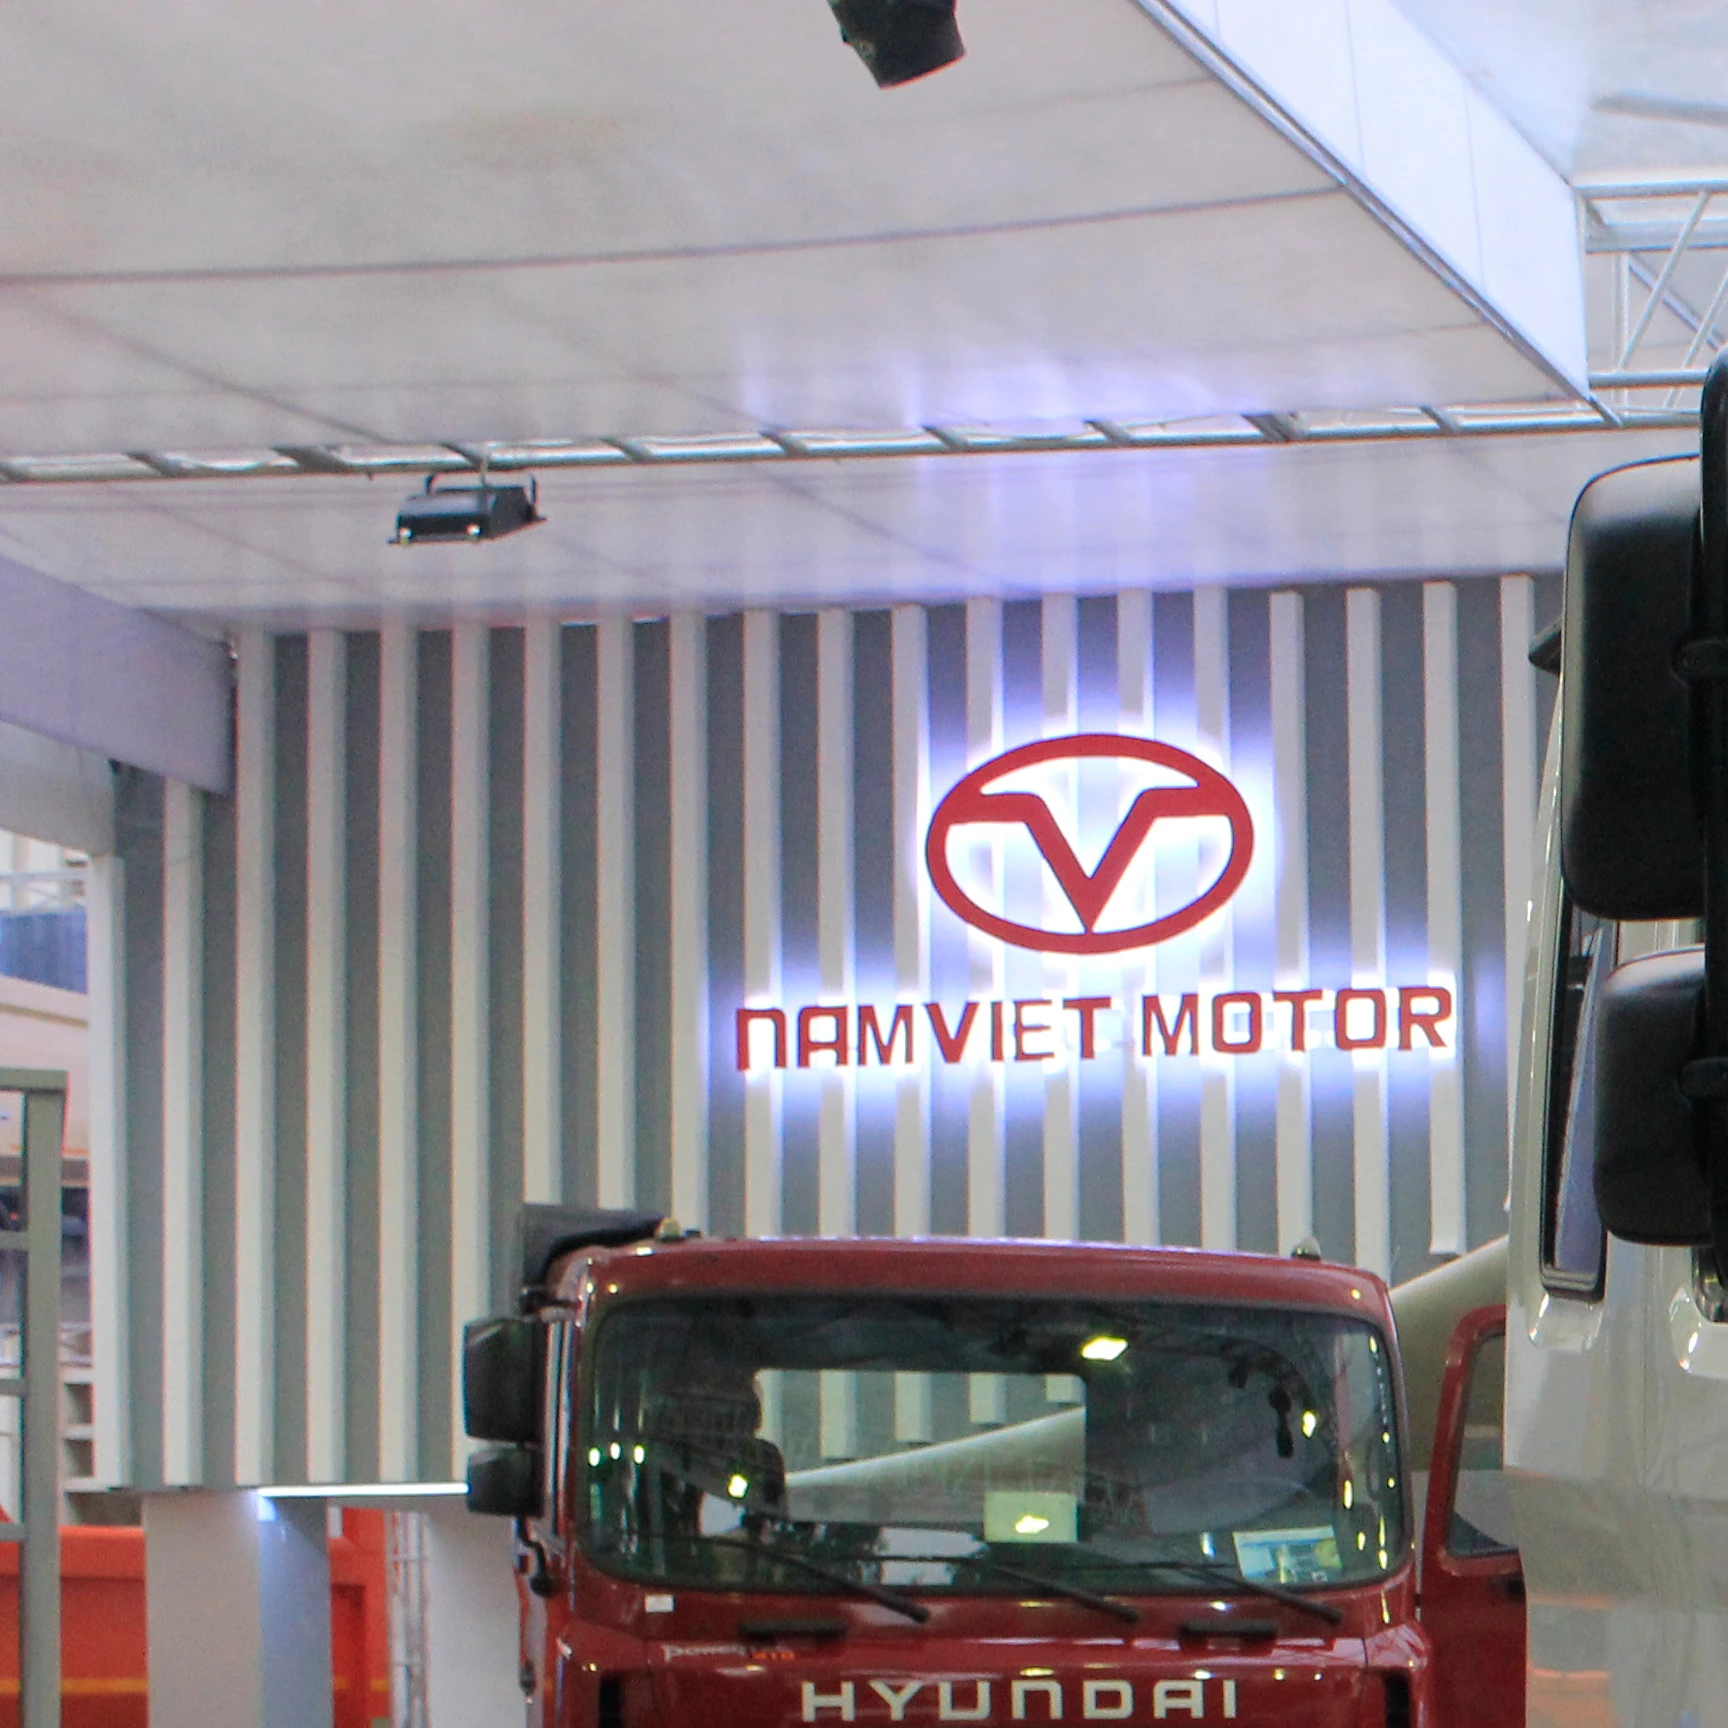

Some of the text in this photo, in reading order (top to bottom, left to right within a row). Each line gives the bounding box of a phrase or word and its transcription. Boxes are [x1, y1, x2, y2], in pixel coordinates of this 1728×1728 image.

[736, 986, 1453, 1072] NAMVIET MOTOR
[802, 1679, 1238, 1722] HYUNDAI
